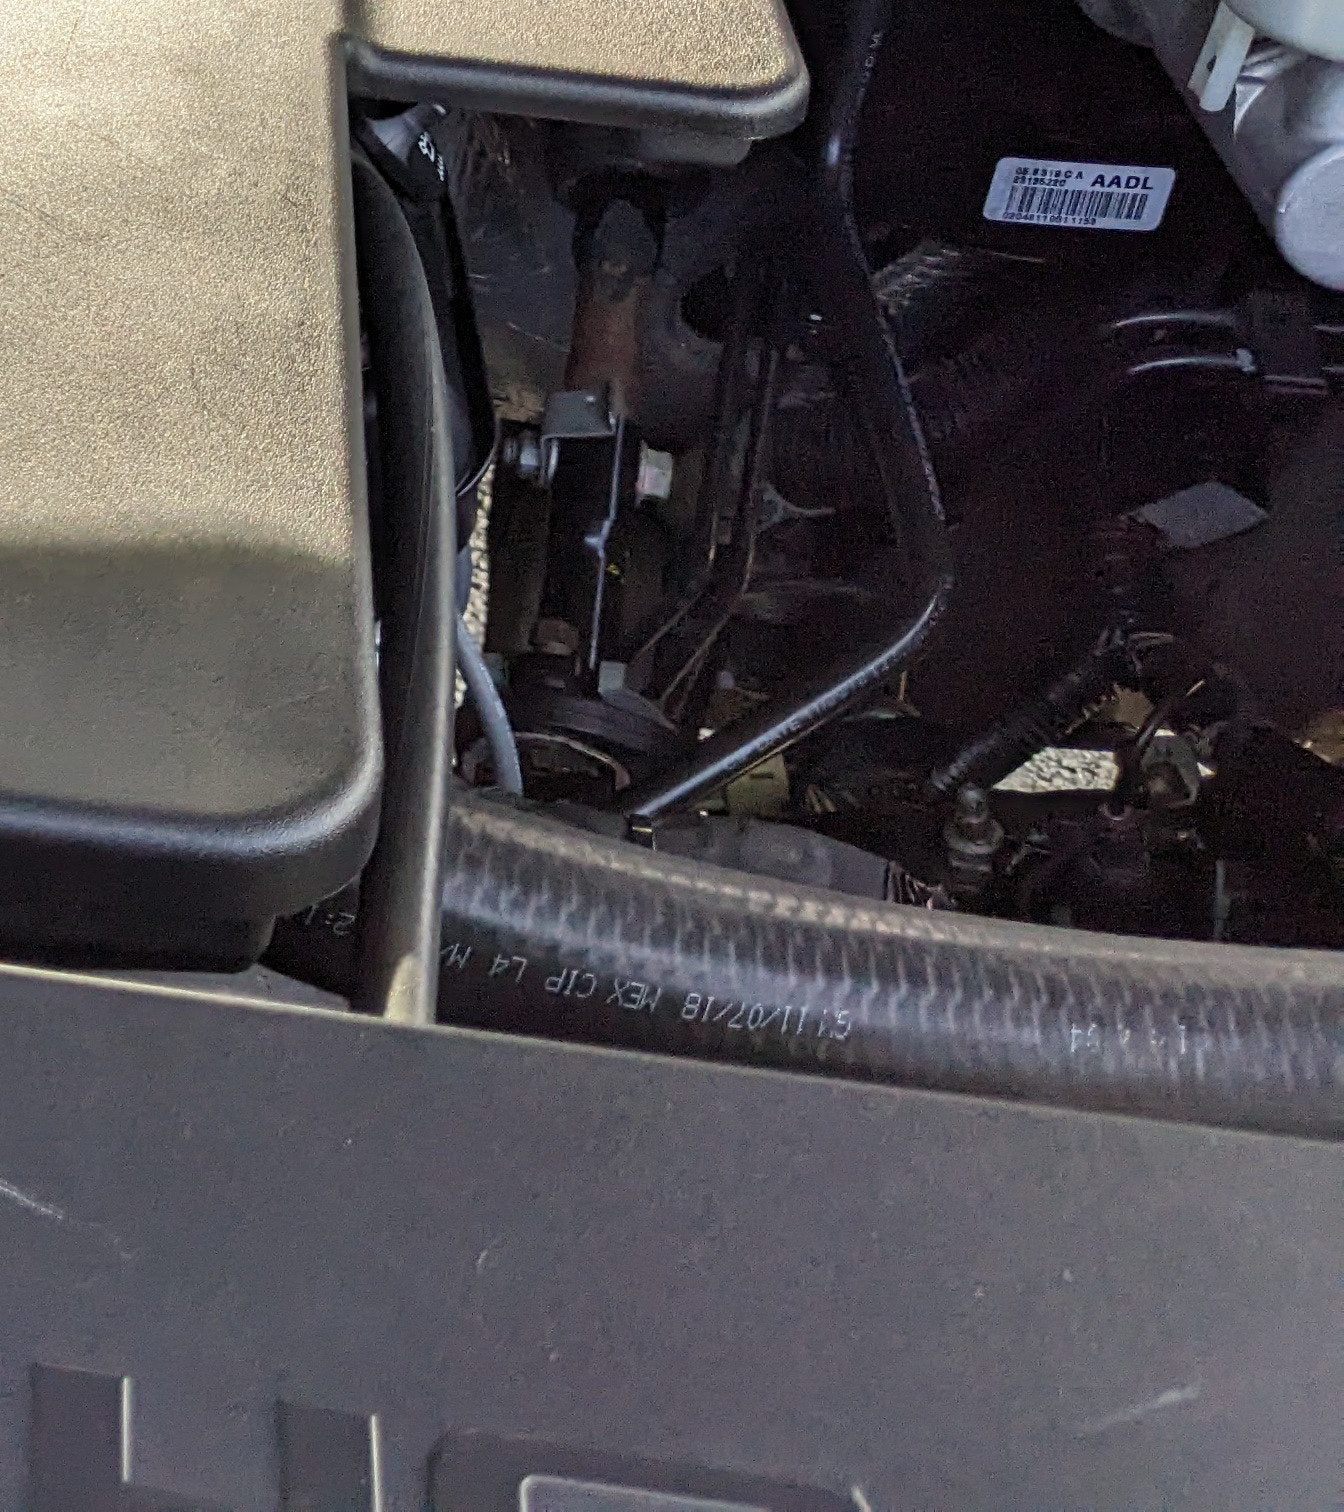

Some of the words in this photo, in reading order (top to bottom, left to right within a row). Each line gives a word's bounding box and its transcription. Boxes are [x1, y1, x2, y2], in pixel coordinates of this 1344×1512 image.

[1090, 174, 1154, 190] AADL
[487, 954, 528, 984] L4
[544, 967, 598, 999] CIP
[605, 977, 662, 1014] MEX
[680, 991, 807, 1036] 11/07/18
